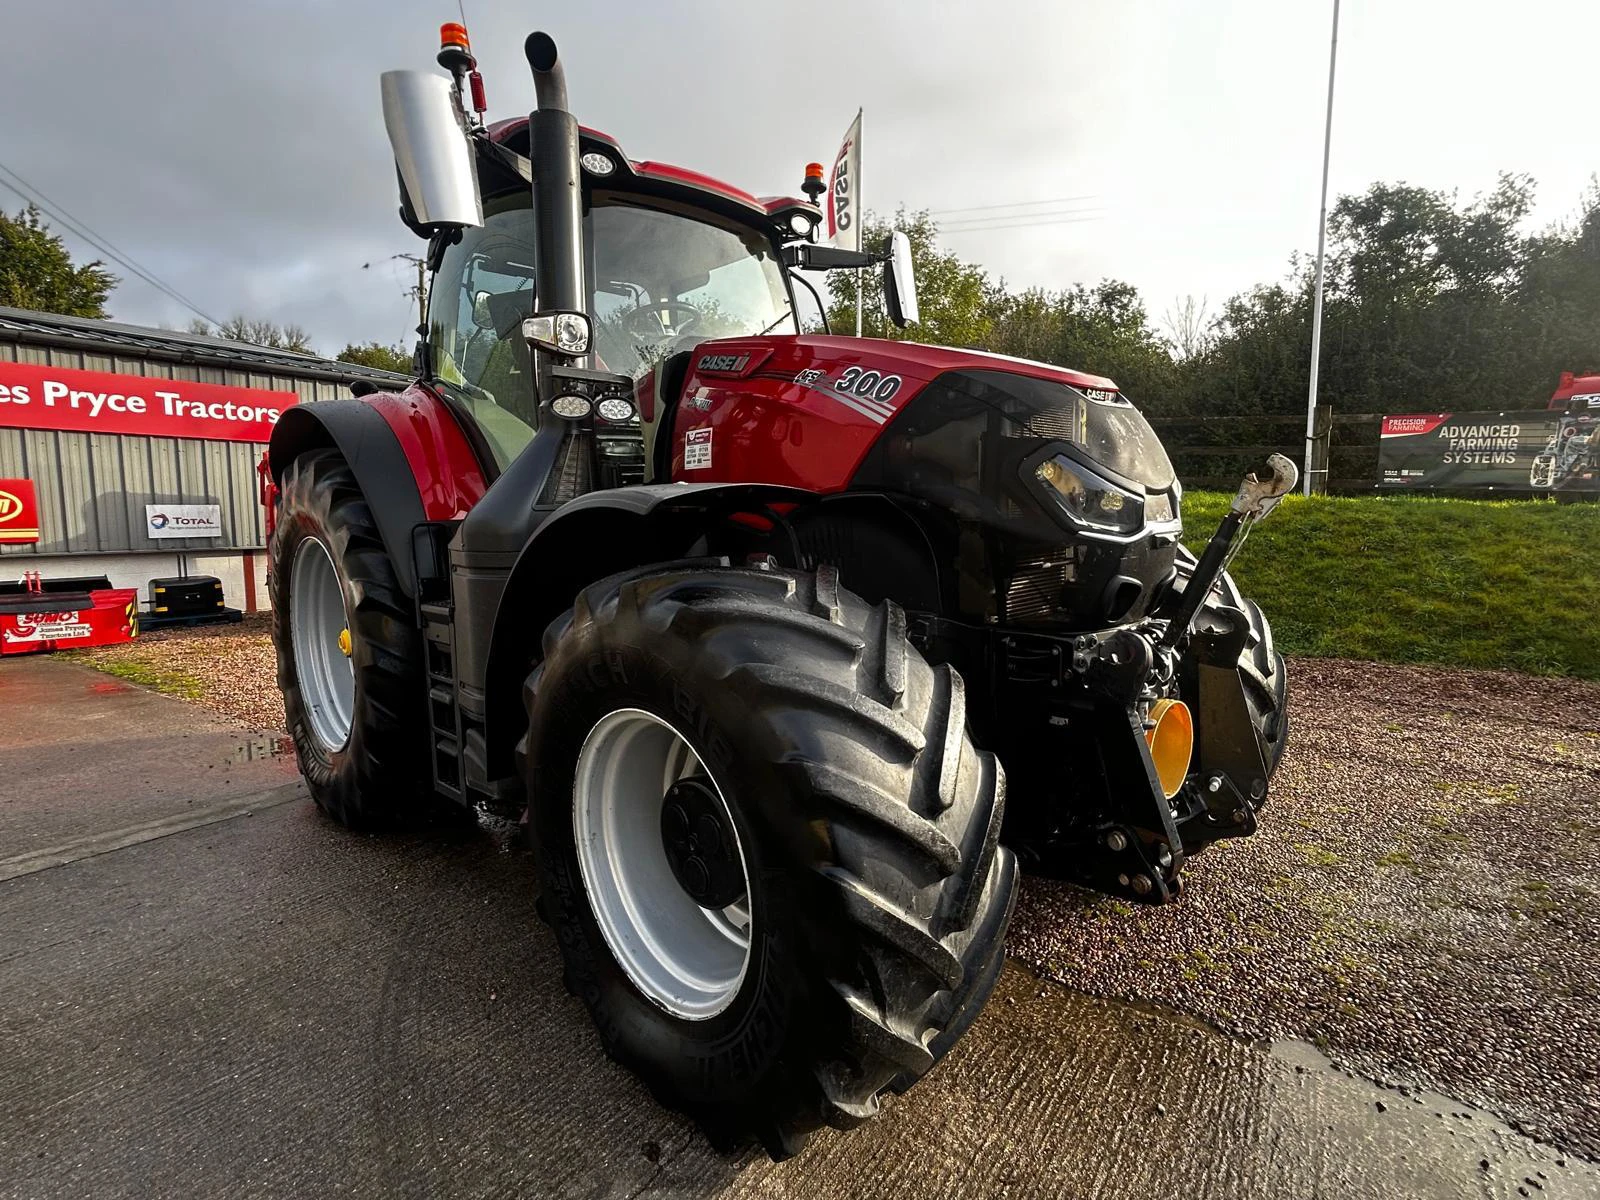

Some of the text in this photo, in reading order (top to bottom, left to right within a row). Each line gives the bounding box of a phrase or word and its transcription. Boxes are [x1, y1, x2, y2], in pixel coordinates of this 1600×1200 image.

[697, 355, 736, 371] CASE
[834, 366, 902, 403] 300
[1086, 388, 1105, 400] CASE
[43, 380, 147, 417] Pryce
[154, 391, 280, 424] Tractors
[1388, 418, 1426, 426] PRECISION
[1439, 424, 1520, 438] ADVANCED
[1449, 438, 1519, 451] FARMING
[1443, 451, 1516, 464] SYSTEMS
[23, 611, 73, 624] SUMO
